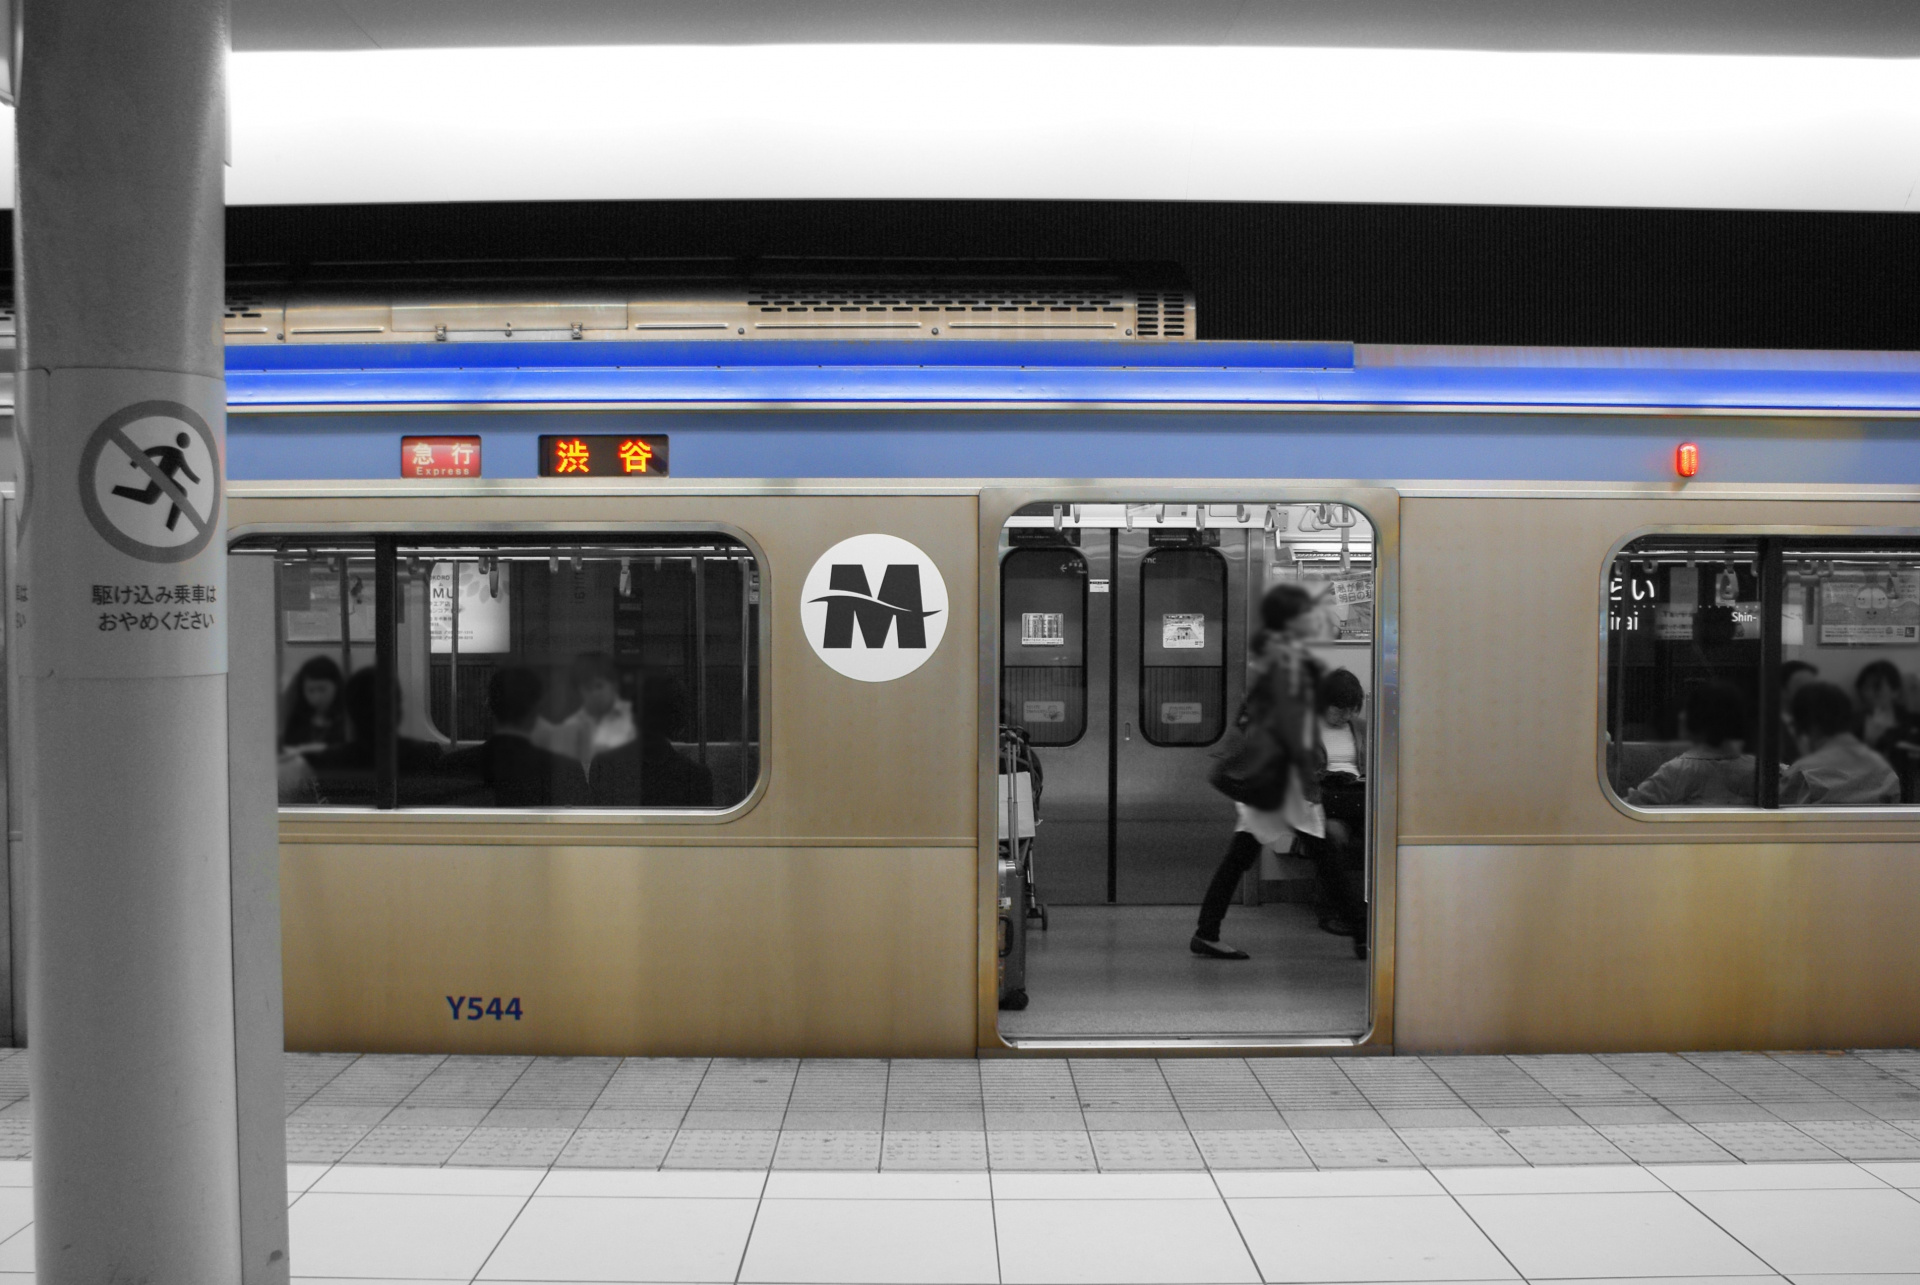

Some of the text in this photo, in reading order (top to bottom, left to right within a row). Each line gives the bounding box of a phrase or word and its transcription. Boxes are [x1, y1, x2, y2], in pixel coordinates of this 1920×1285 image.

[412, 442, 474, 465] 急行
[556, 440, 653, 473] 渋谷
[416, 467, 470, 476] Express
[92, 584, 216, 605] 駆け込み乗車は
[98, 611, 214, 632] おやめください
[1731, 611, 1758, 623] Shin-
[446, 996, 523, 1020] Y544
